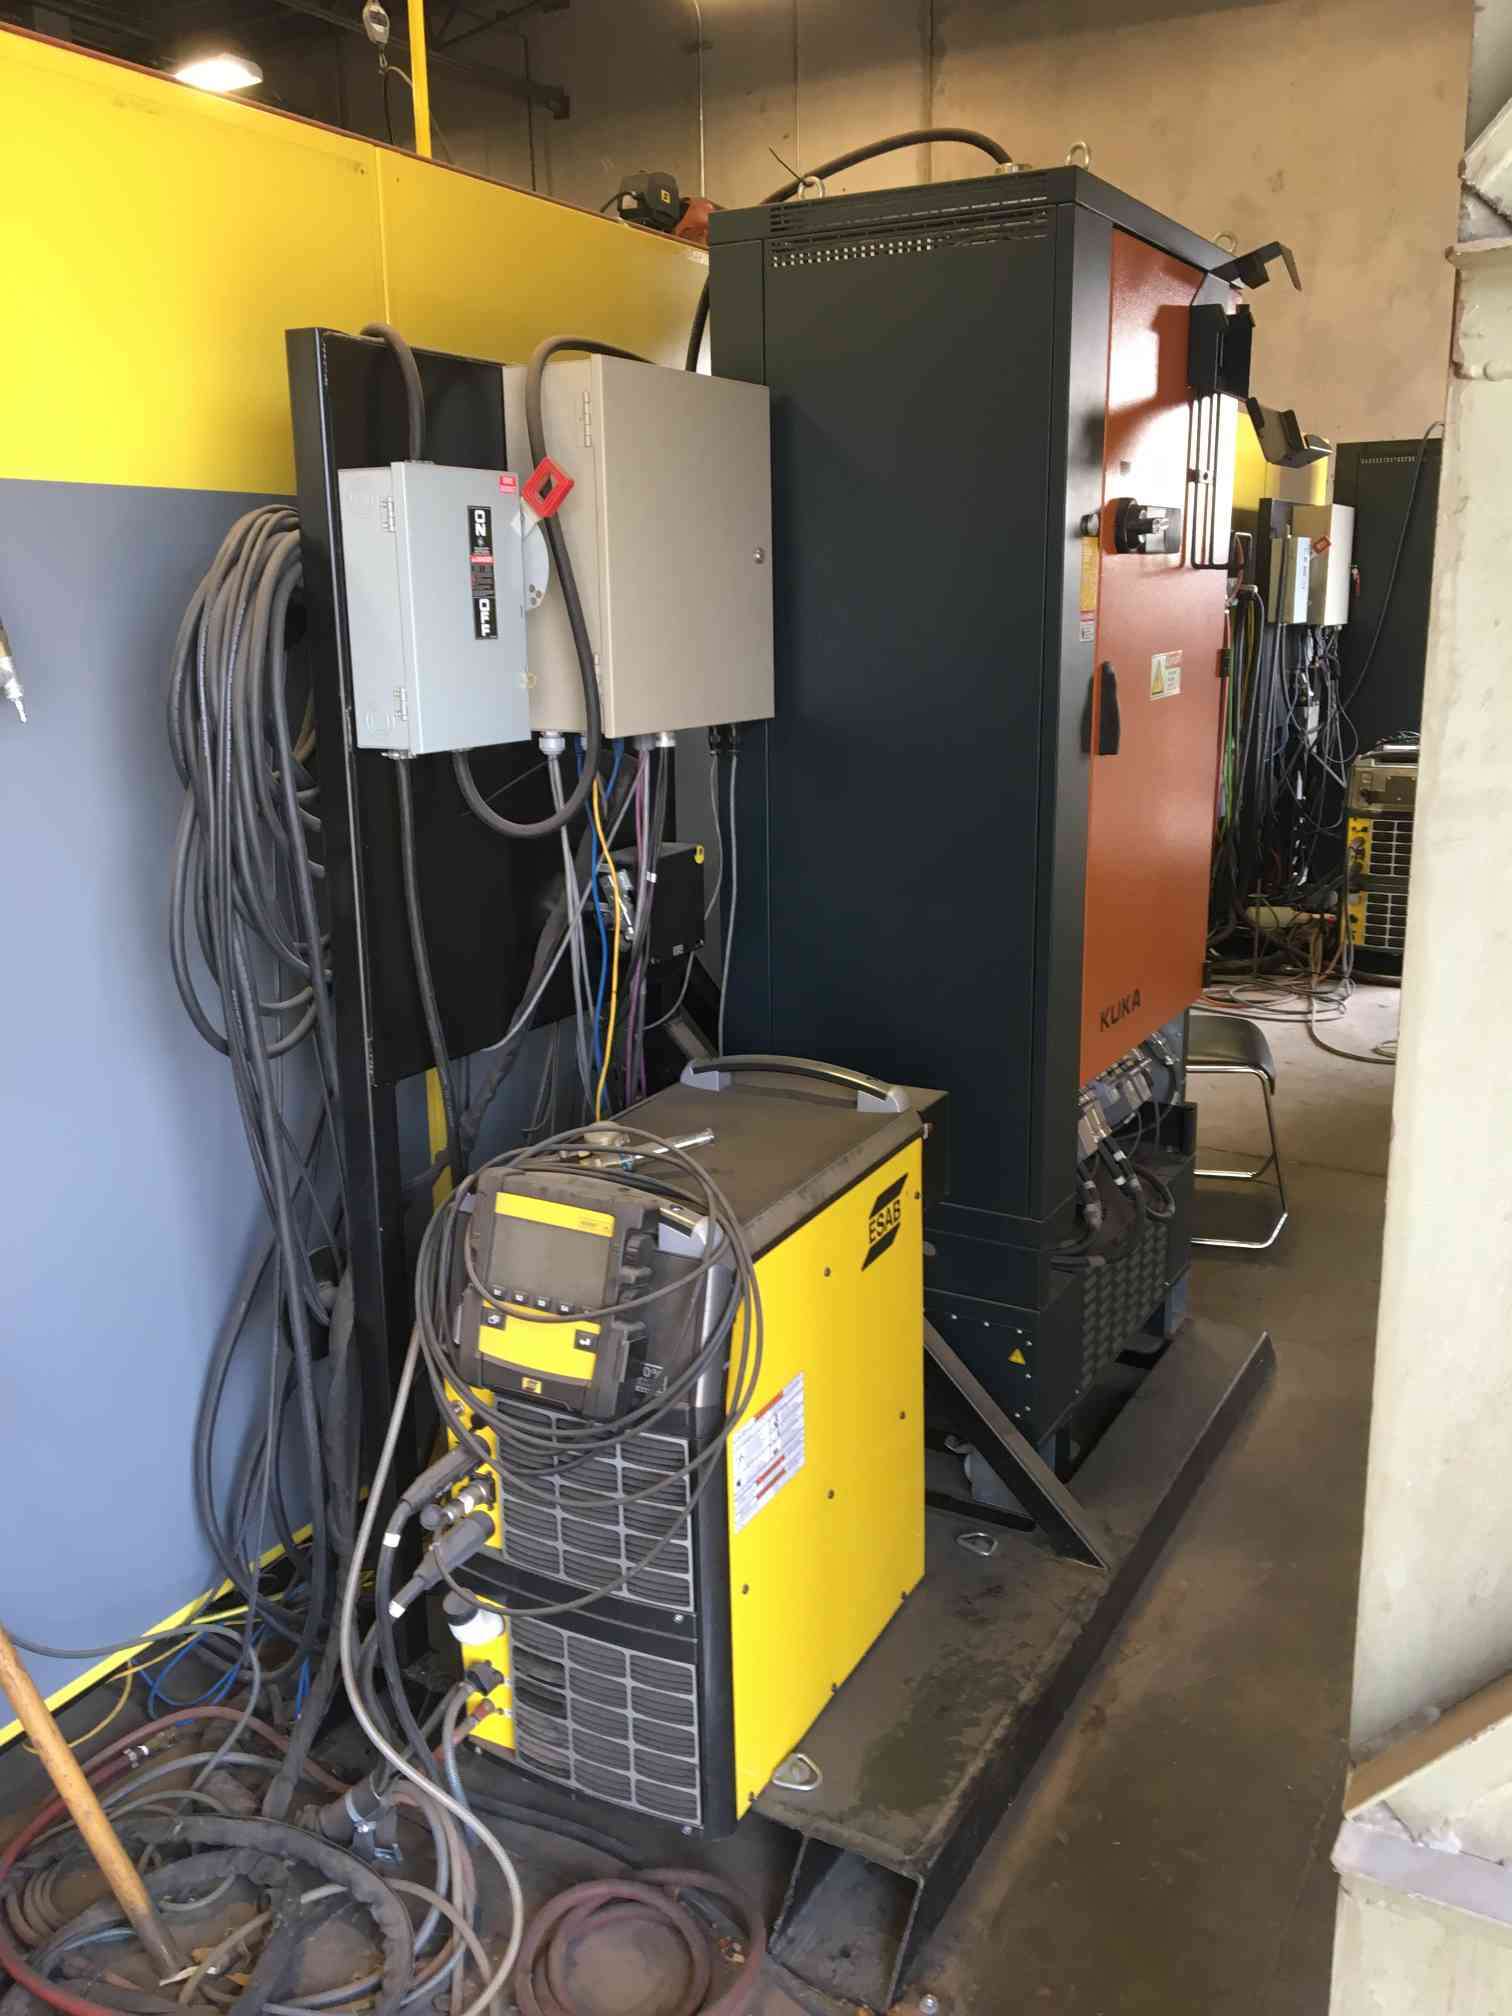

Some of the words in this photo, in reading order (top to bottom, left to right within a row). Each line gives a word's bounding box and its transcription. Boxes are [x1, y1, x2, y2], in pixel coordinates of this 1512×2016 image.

[474, 510, 487, 537] ON
[479, 598, 491, 637] OFF
[1100, 988, 1141, 1032] KUKA
[868, 1199, 901, 1244] ESAB
